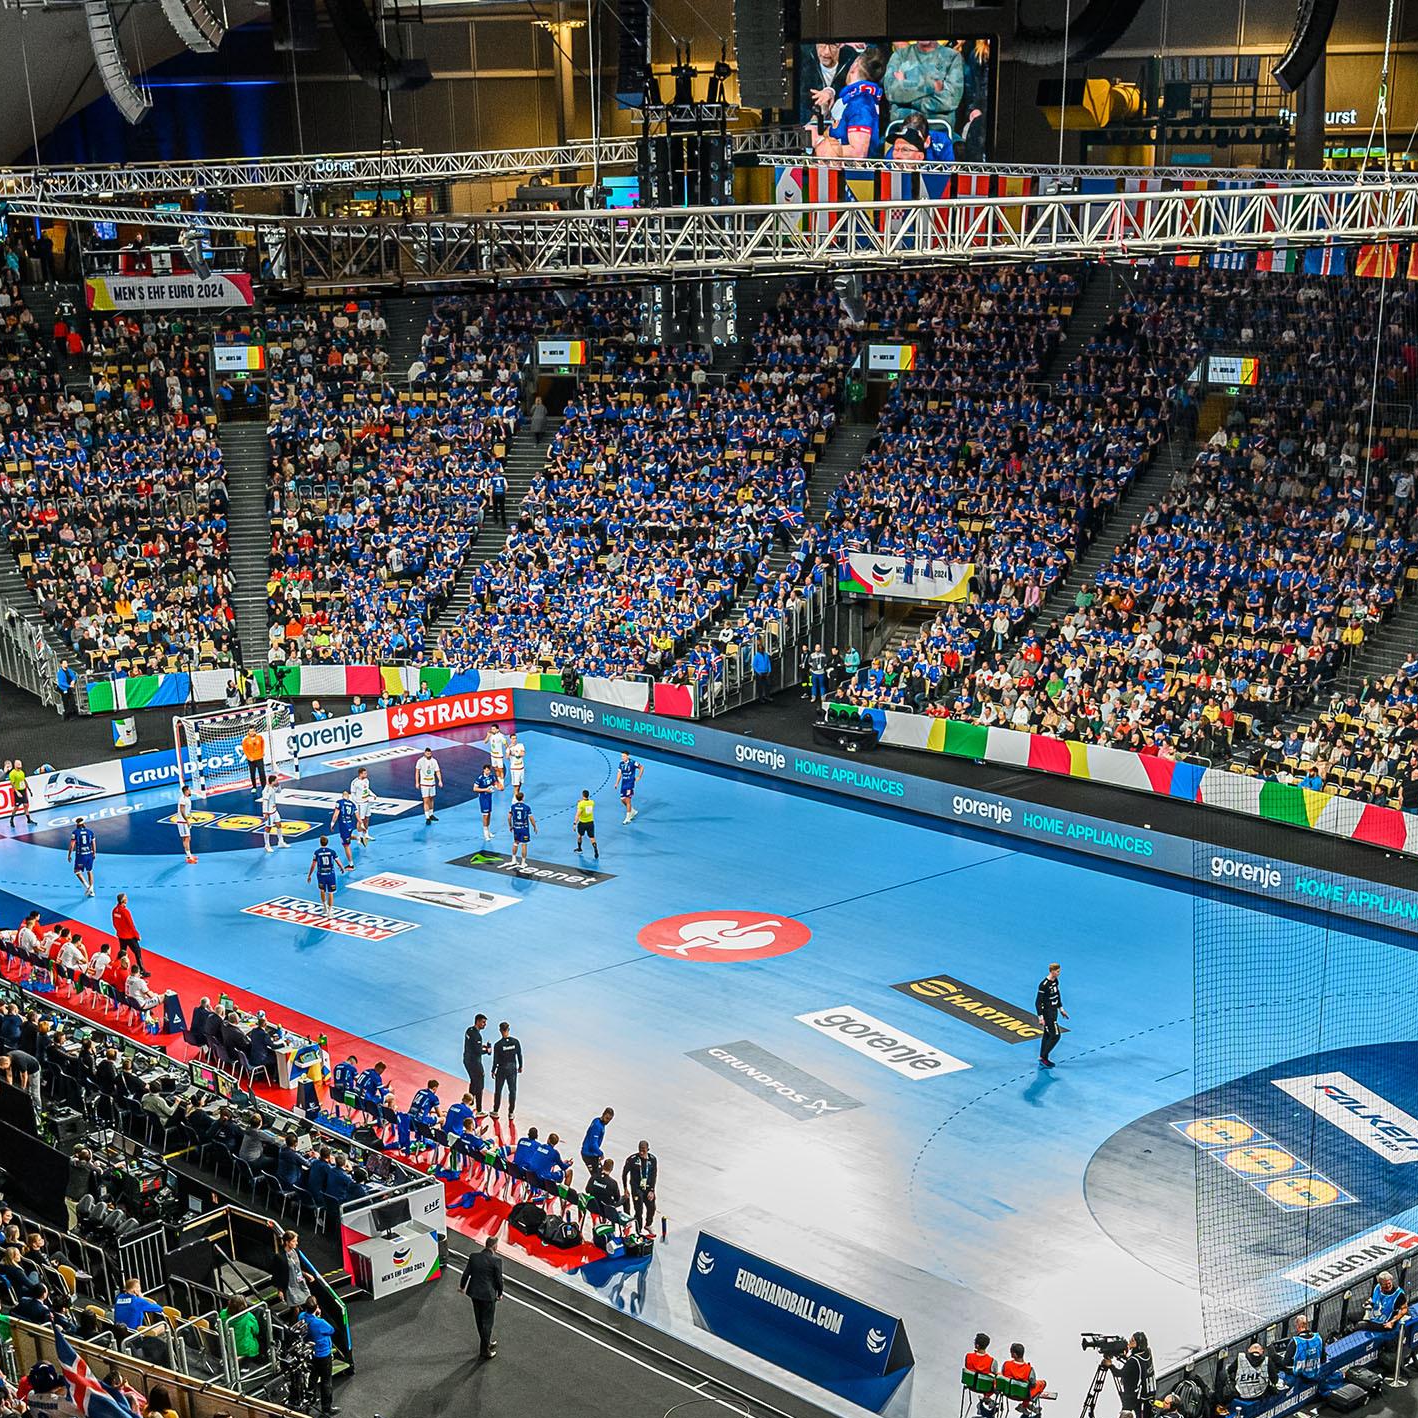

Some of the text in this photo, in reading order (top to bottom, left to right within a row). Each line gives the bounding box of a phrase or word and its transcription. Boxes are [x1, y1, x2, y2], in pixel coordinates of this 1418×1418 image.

[148, 284, 166, 299] EHF
[168, 284, 195, 299] EURO
[197, 283, 224, 299] 2024
[287, 718, 363, 754] gorenje
[413, 700, 508, 730] STRAUSS
[550, 701, 695, 747] gorenje HOME APPLIANCES
[128, 751, 235, 785] GRUNDFOS
[735, 744, 905, 797] gorenje HOME APPLIANCES
[952, 795, 1153, 857] gorenje HOME APPLIANCES
[1211, 856, 1281, 888] gorenje
[1294, 875, 1344, 902] HOME
[250, 903, 393, 940] MOLY MOLY
[943, 992, 1045, 1038] HARTING
[814, 1010, 945, 1071] gorenje
[706, 1046, 809, 1104] GRUNDFOS
[424, 1199, 440, 1213] EHF
[1302, 1244, 1394, 1288] WÜRTH
[735, 1268, 845, 1335] EUROHANDBALL.COM
[1274, 1397, 1299, 1418] HANDBALL
